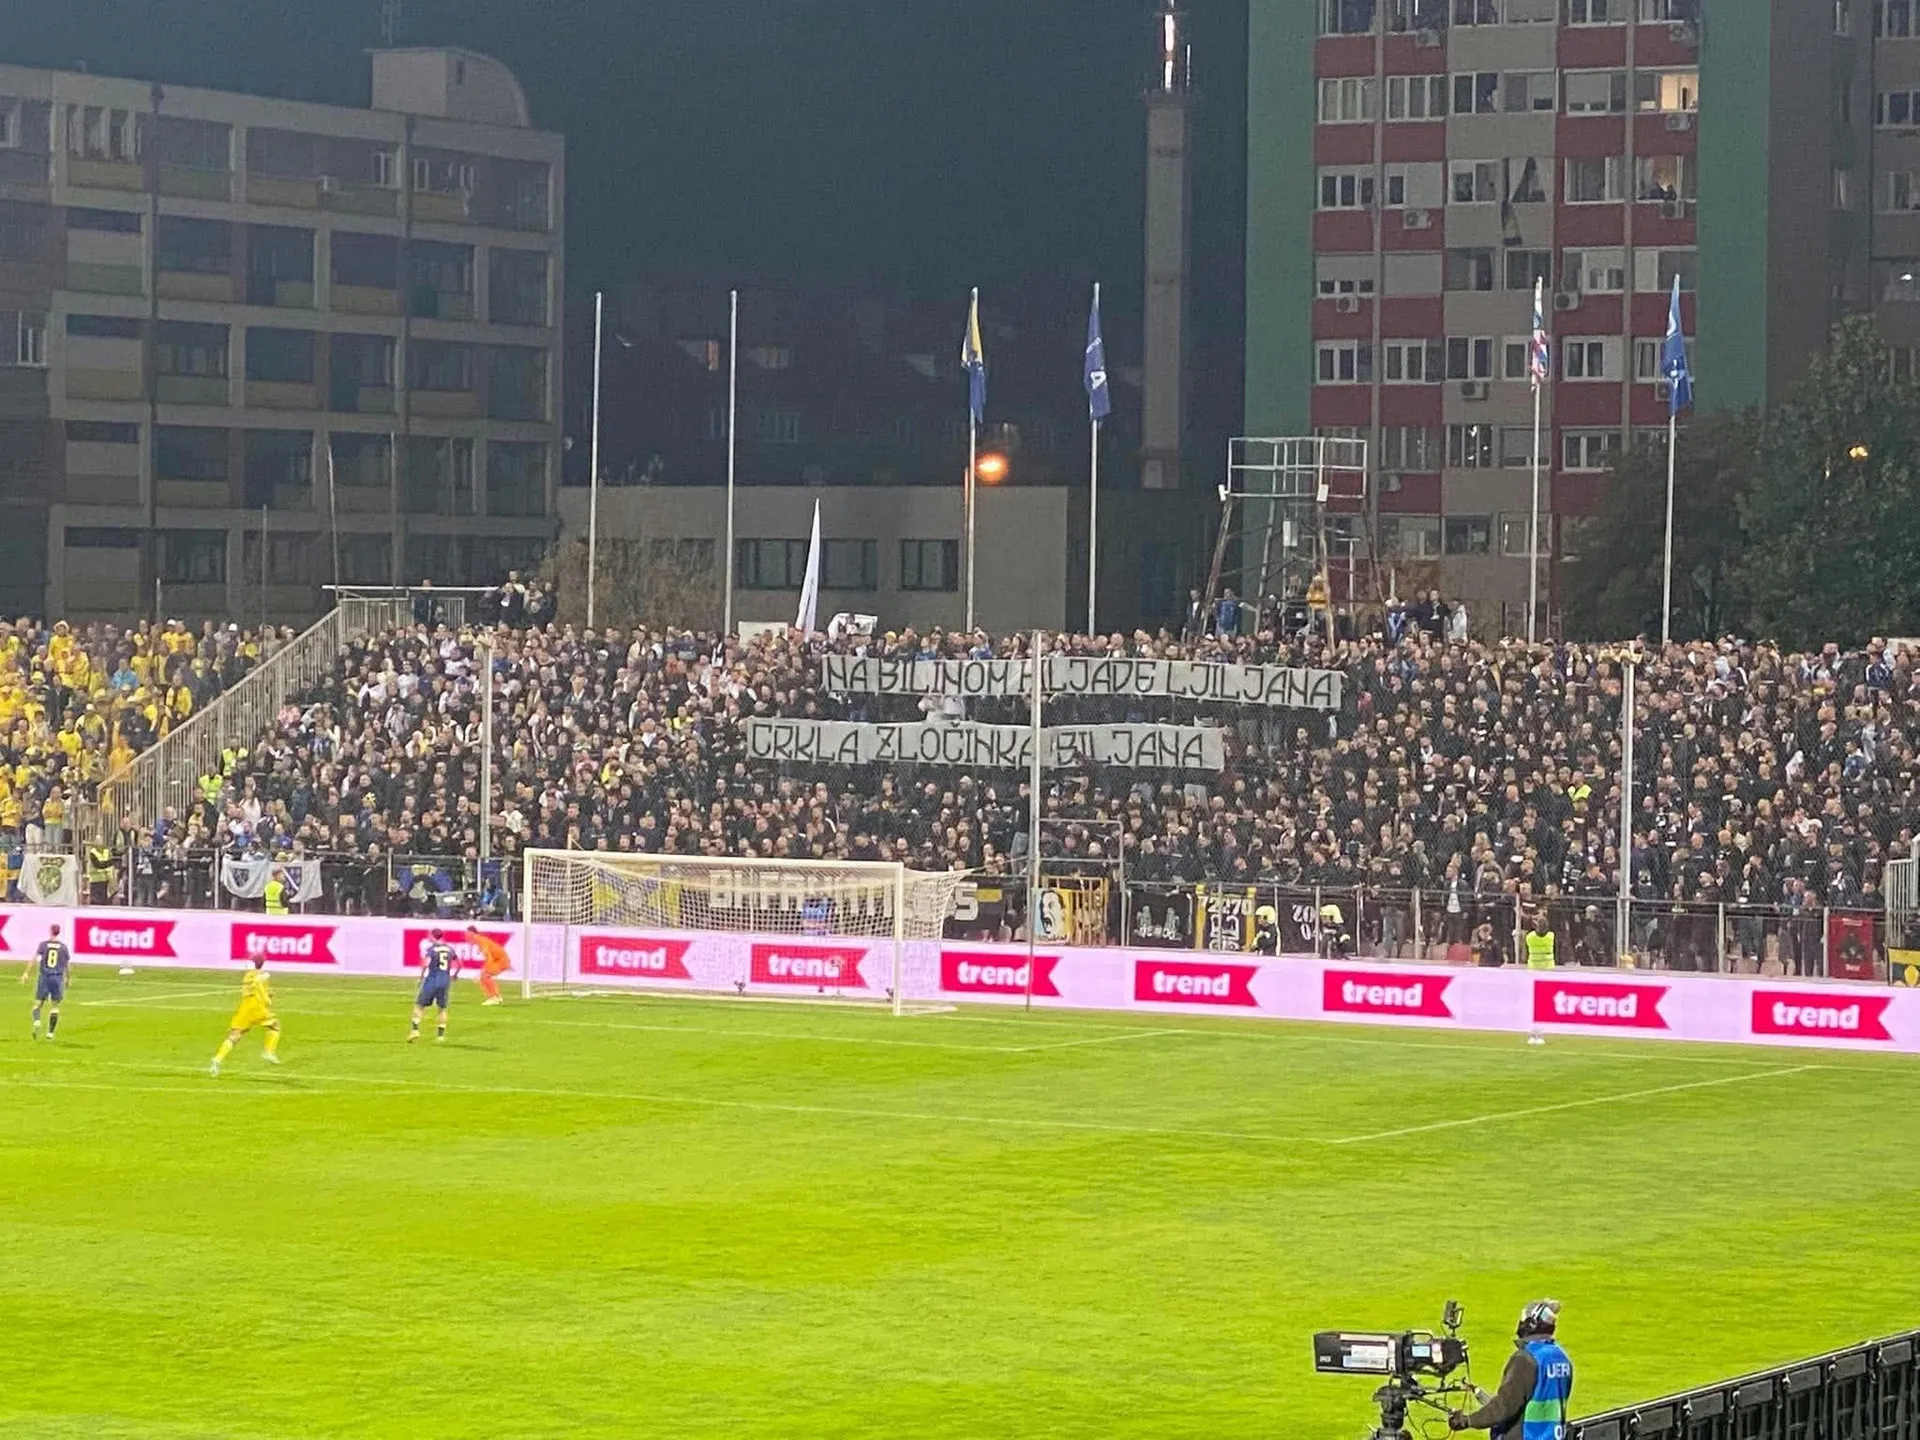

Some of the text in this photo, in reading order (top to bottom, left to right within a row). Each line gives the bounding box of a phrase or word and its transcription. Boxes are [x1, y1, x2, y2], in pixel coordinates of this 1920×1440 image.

[826, 656, 868, 691] NA
[878, 658, 1008, 694] BILINOM
[1166, 661, 1332, 706] LJILJANA
[752, 723, 859, 762] CRKLA
[87, 924, 153, 950] trend
[246, 928, 312, 955] trend
[47, 949, 58, 968] 8
[439, 951, 449, 971] 5
[596, 944, 666, 970] trend
[957, 960, 1031, 987] trend
[1153, 970, 1230, 997] trend
[1342, 980, 1422, 1008] trend
[1553, 991, 1637, 1018] trend
[1772, 1001, 1859, 1030] trend
